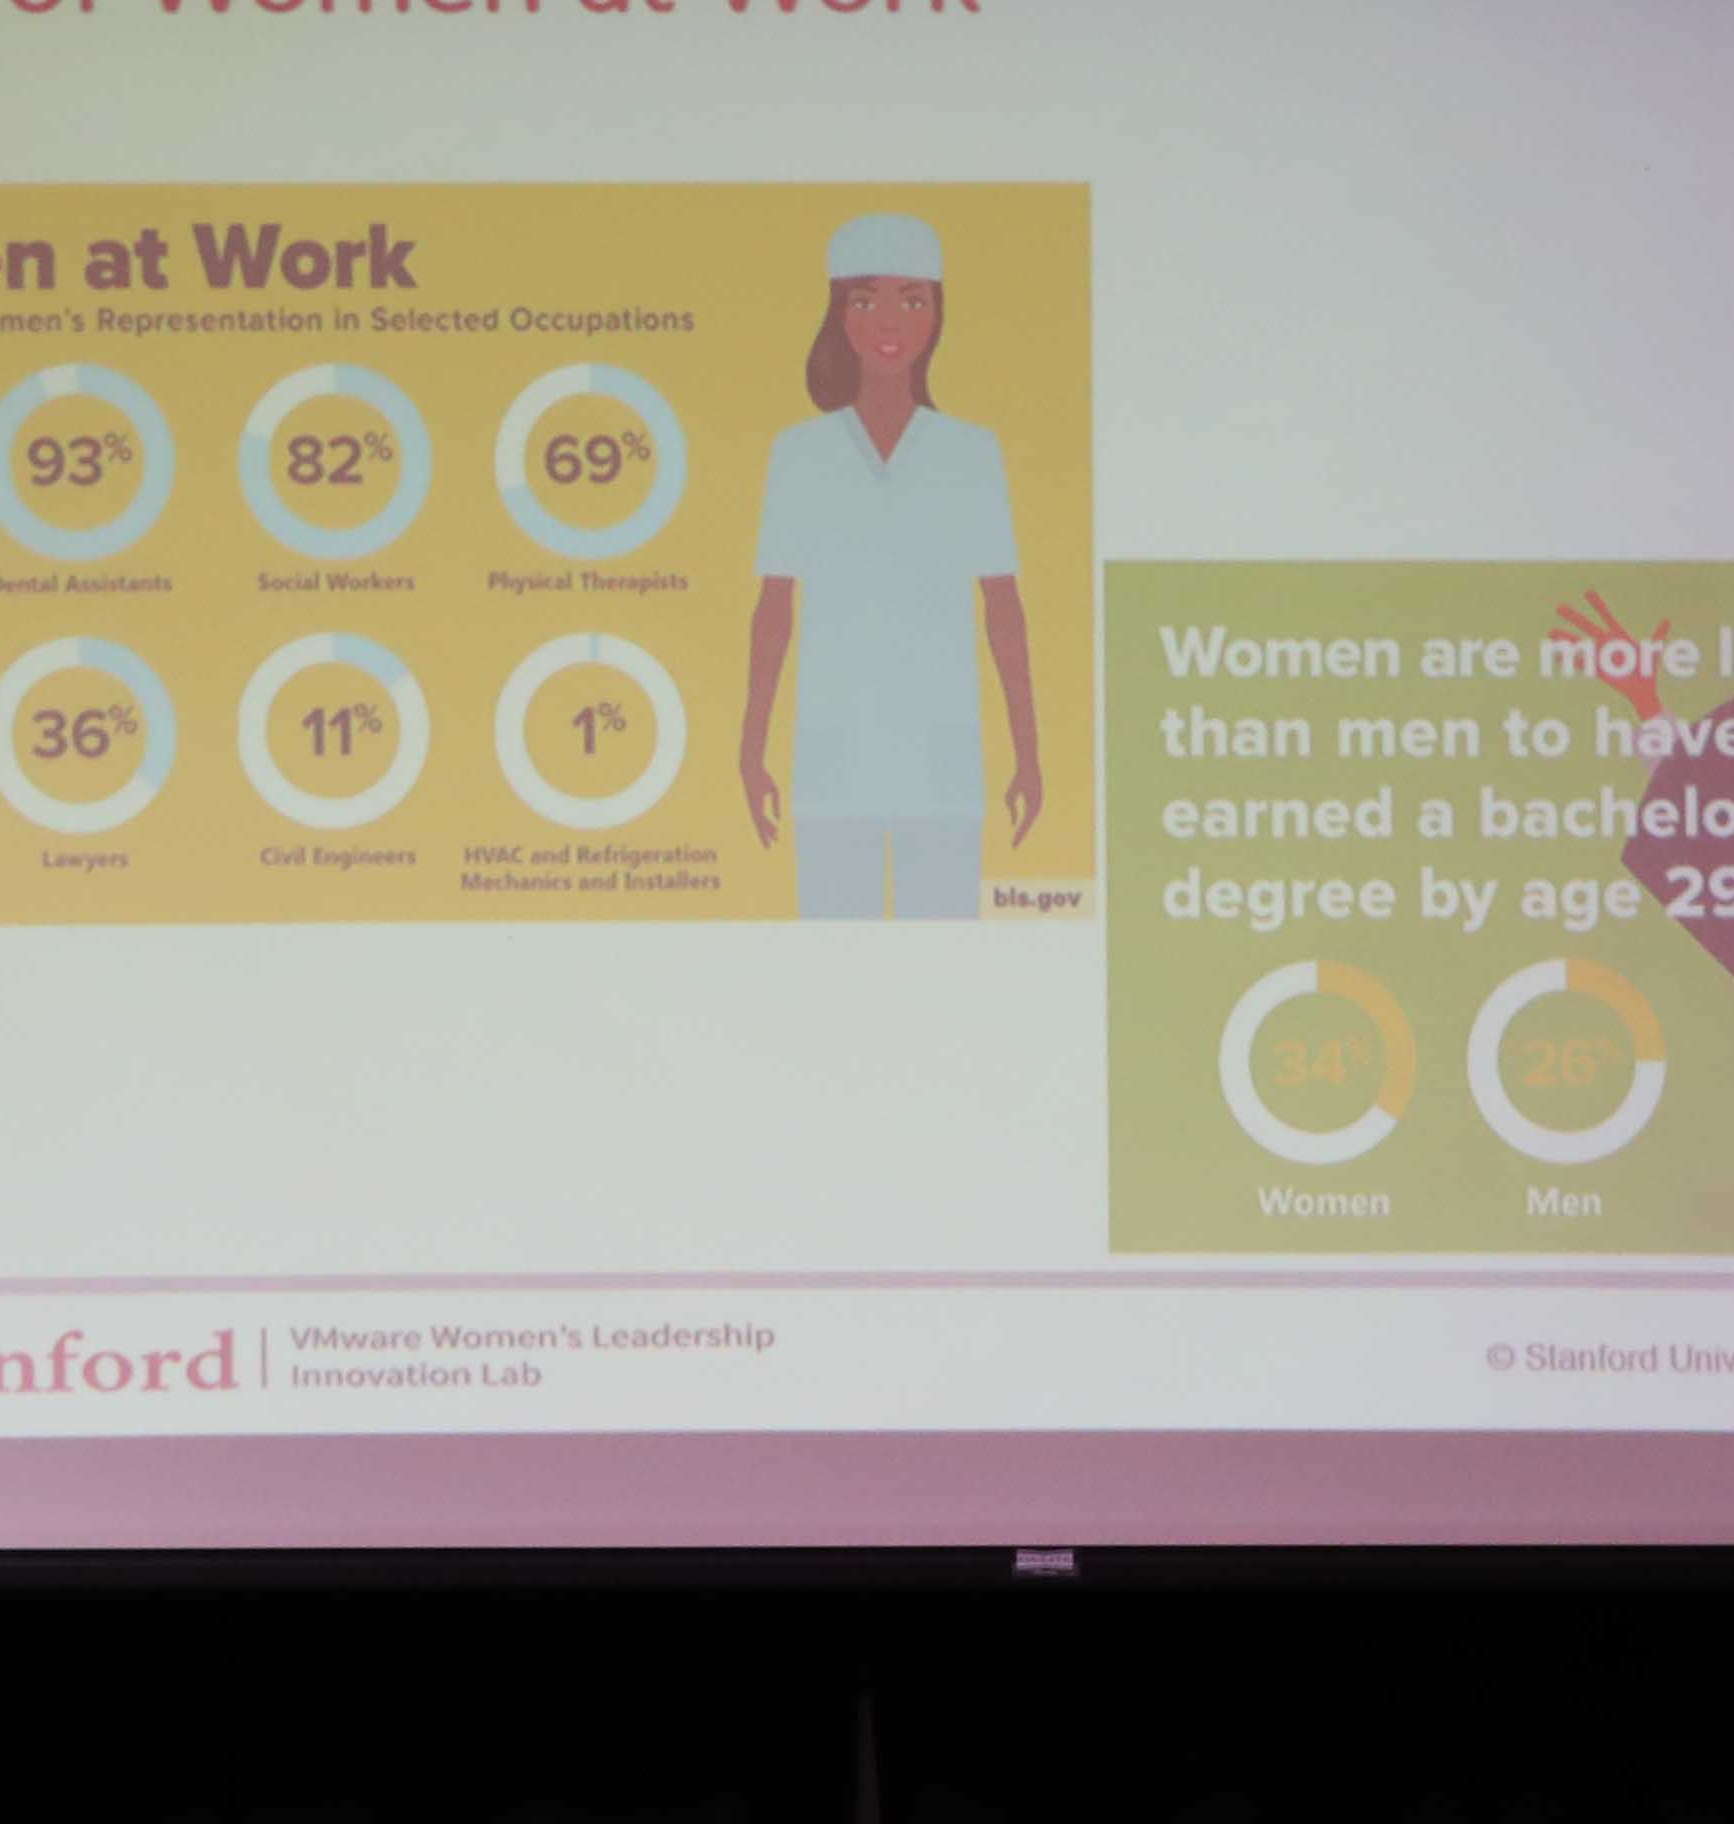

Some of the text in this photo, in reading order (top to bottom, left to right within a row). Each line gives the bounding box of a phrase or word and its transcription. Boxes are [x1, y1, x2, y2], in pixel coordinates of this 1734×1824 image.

[84, 228, 168, 290] at
[192, 222, 418, 290] Work
[97, 307, 322, 336] Representation
[334, 307, 360, 332] in
[370, 306, 499, 332] Selected
[509, 305, 695, 336] Occupations
[26, 431, 133, 487] 93%
[286, 430, 394, 486] 82%
[544, 429, 652, 485] 69%
[65, 574, 173, 594] Assistants
[257, 571, 416, 593] Social Workers
[488, 571, 689, 597] Physical Therapists
[1158, 625, 1401, 678] Women
[1419, 635, 1520, 678] are
[1539, 635, 1700, 678] more
[30, 703, 138, 760] 36%
[301, 701, 383, 757] 11%
[570, 700, 627, 756] 1%
[1159, 706, 1311, 758] than
[1337, 716, 1480, 758] men
[1502, 708, 1569, 758] to
[1161, 786, 1394, 838] earned
[1417, 796, 1453, 838] a
[42, 849, 129, 873] Lawyers
[259, 846, 417, 870] Civil Engineers
[463, 843, 718, 869] HVAC and Refrigeration
[459, 870, 722, 892] Mechanics and Installers
[992, 885, 1083, 914] bls.gov
[1162, 866, 1396, 933] degree
[1420, 866, 1497, 933] by
[1520, 876, 1643, 933] age
[1257, 1186, 1391, 1217] Women
[1525, 1186, 1603, 1217] Men
[289, 1322, 776, 1353] VMware Women's Leadership
[1525, 1343, 1659, 1373] Stanford
[290, 1362, 543, 1388] Innovation Lab
